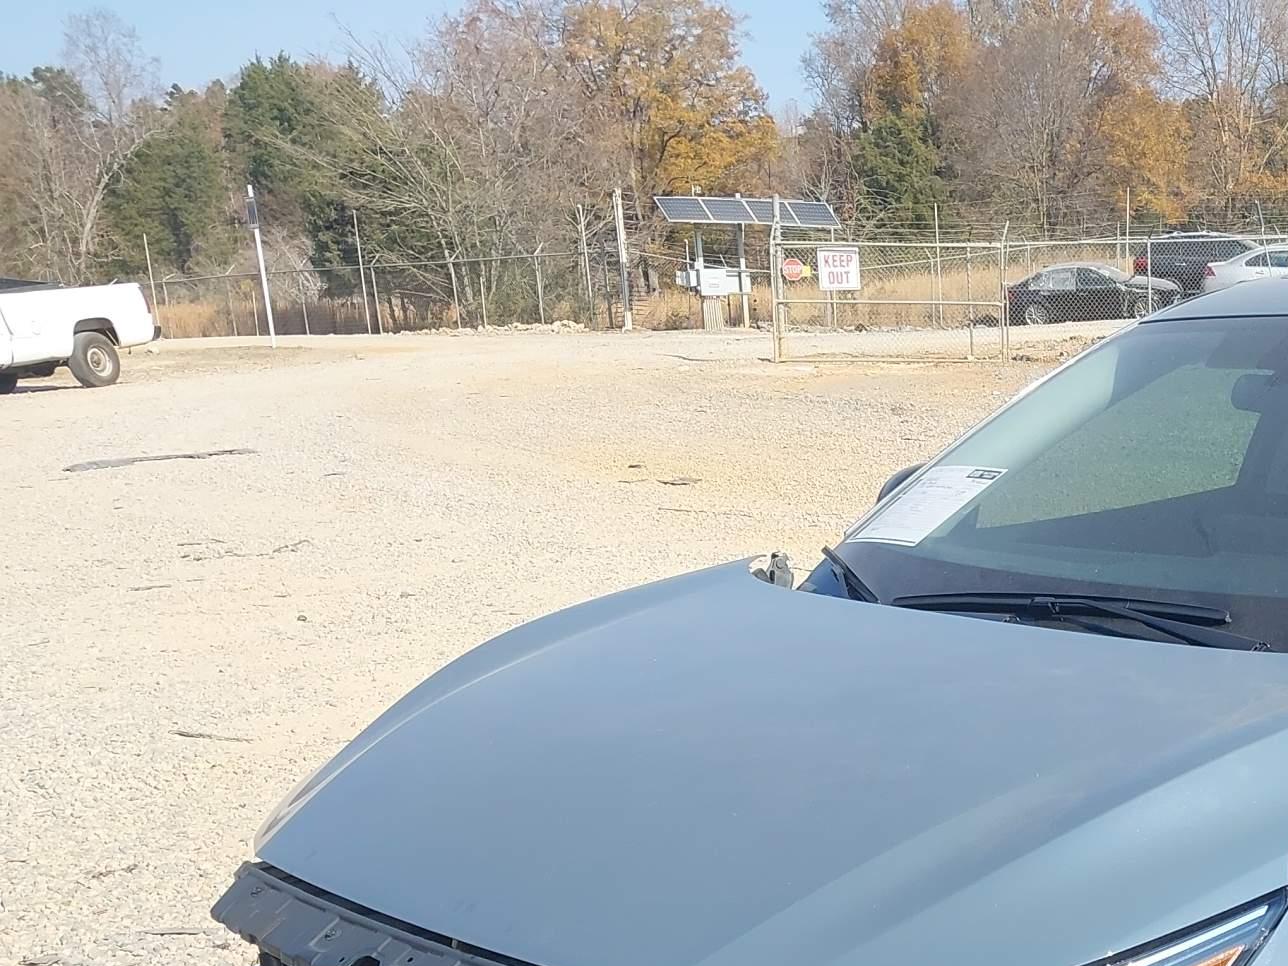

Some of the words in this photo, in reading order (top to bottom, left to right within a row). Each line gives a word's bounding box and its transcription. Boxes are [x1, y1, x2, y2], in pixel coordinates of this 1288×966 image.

[823, 254, 853, 269] KEEP
[783, 265, 802, 274] STOP
[828, 271, 850, 285] OUT
